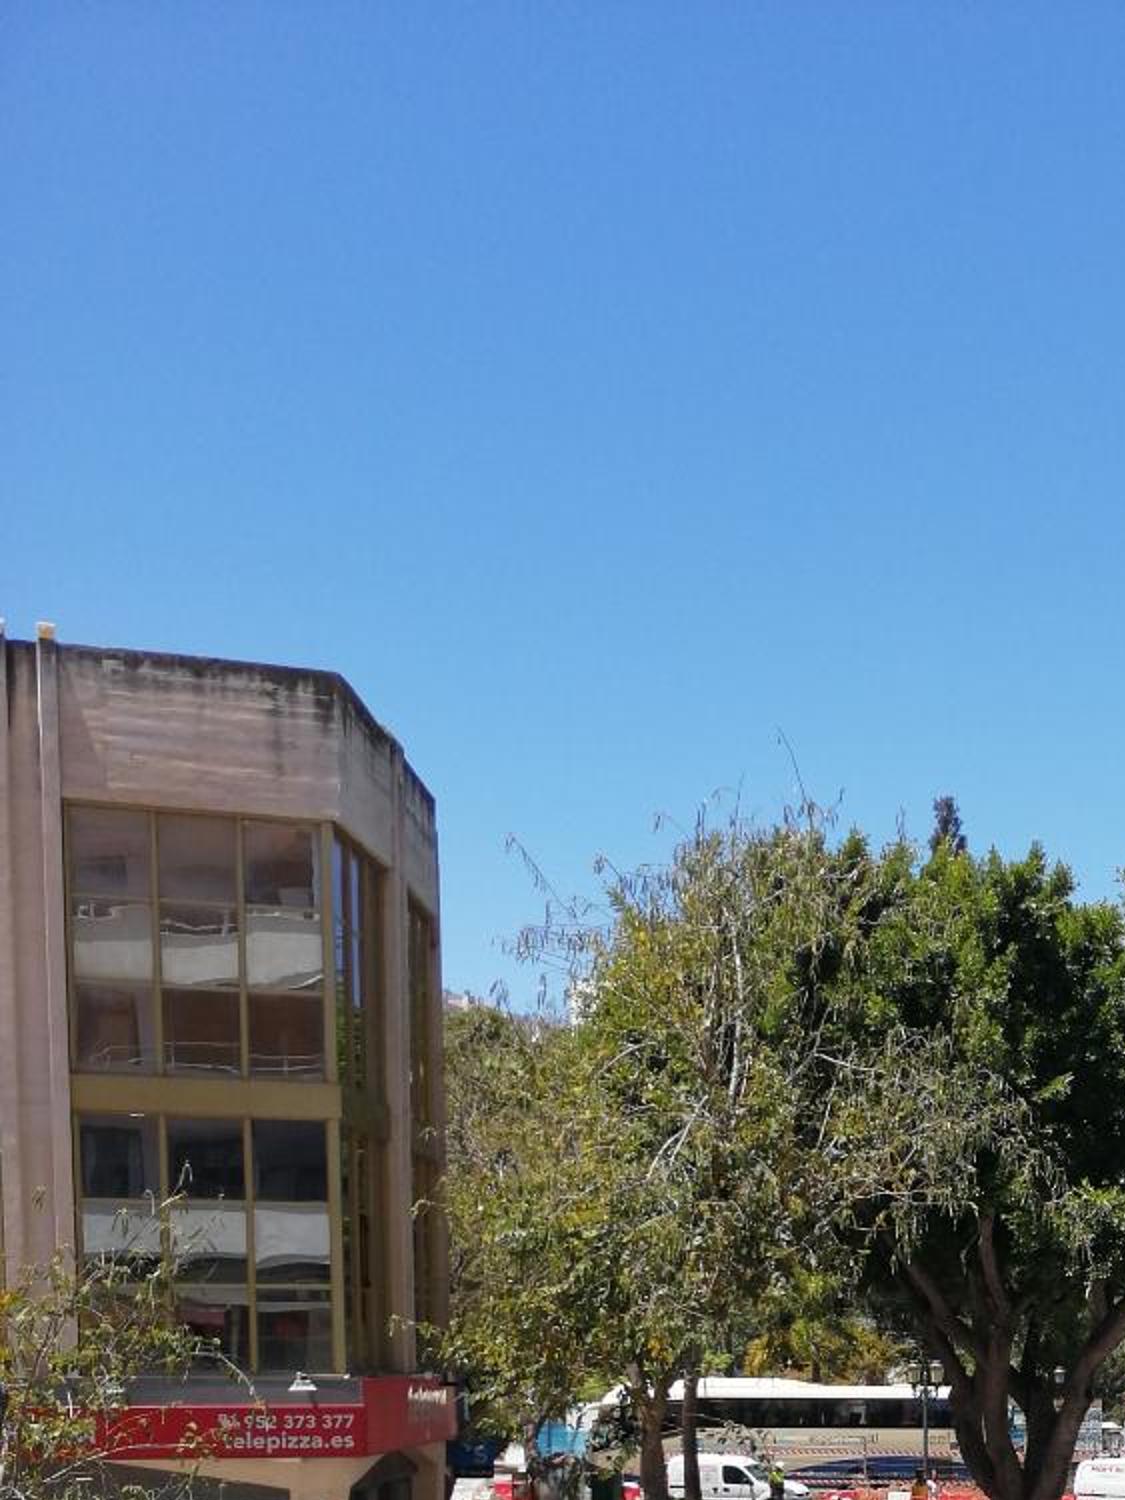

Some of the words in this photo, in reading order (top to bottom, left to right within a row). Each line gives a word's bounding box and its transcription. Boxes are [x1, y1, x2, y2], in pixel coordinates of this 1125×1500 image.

[284, 1414, 317, 1429] 373
[322, 1414, 355, 1429] 377
[223, 1431, 355, 1454] telepizza.es
